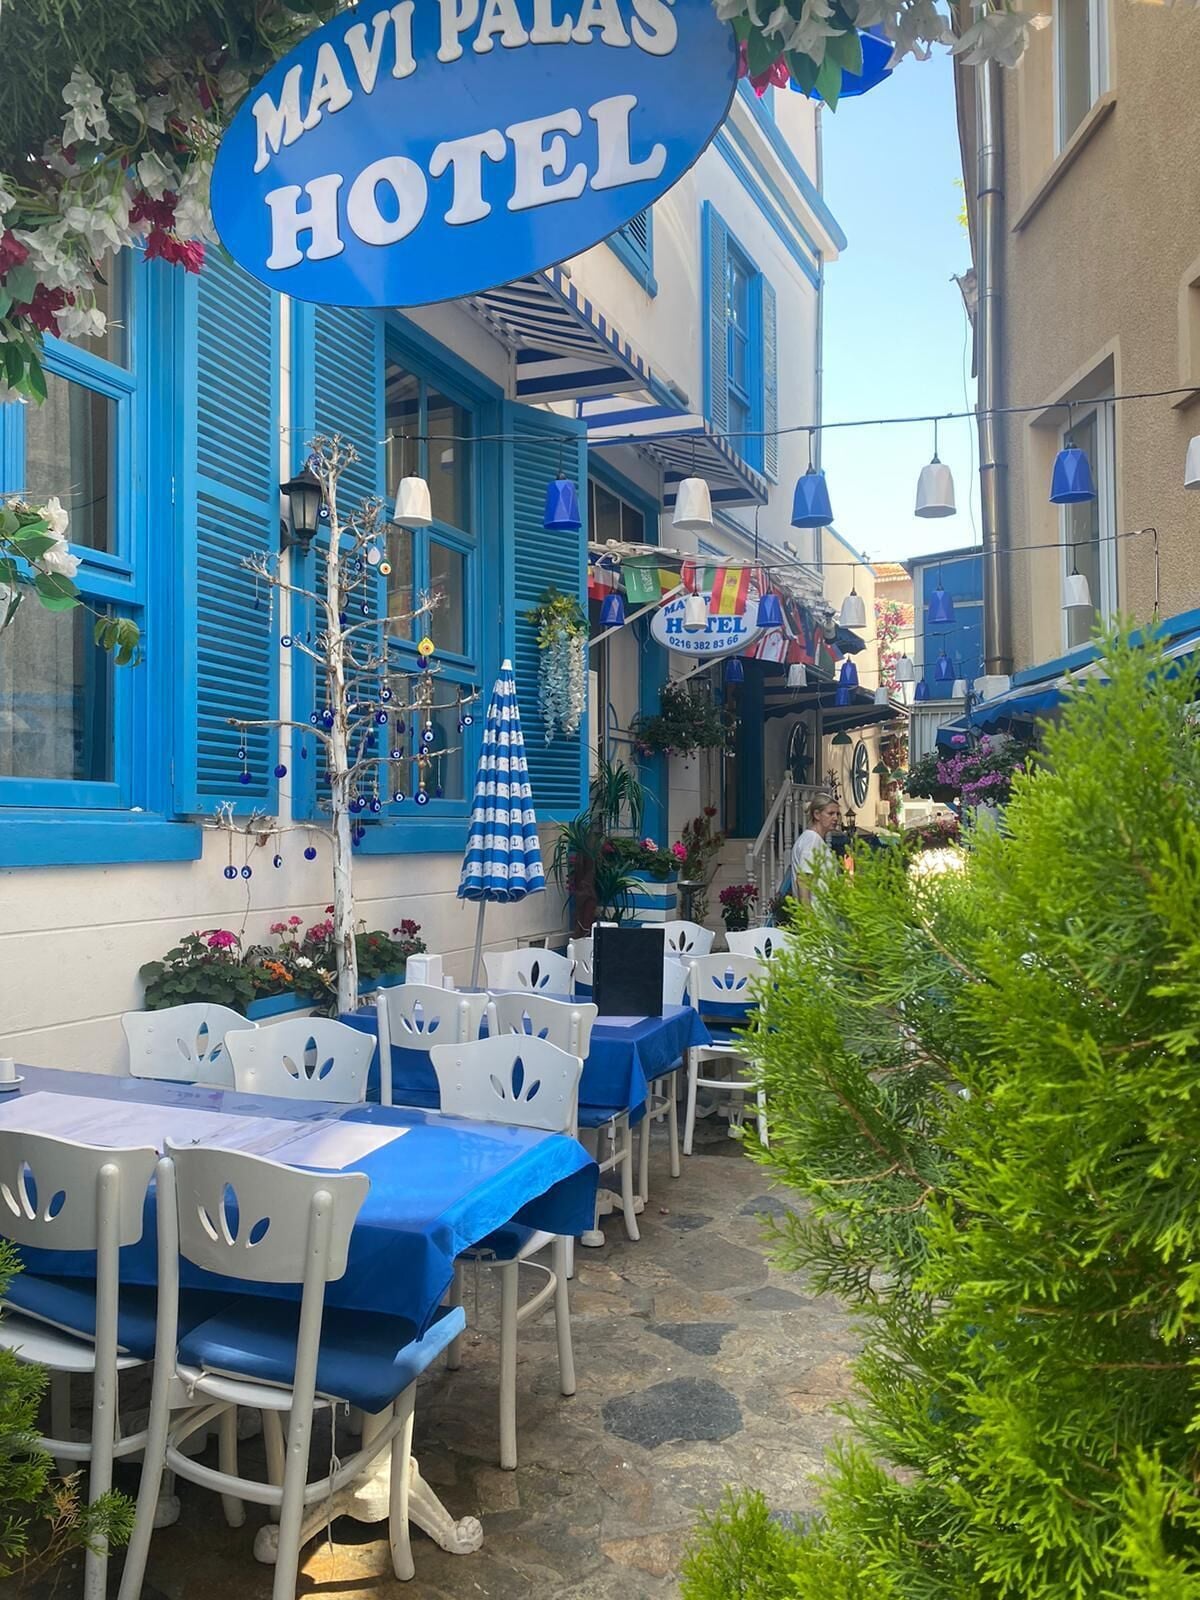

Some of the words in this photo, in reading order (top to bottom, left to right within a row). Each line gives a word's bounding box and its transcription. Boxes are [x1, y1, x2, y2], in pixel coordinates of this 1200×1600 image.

[252, 2, 416, 174] MAVI
[437, 0, 678, 62] PALAS
[265, 94, 667, 270] HOTEL
[666, 617, 747, 633] HTEL
[669, 636, 691, 649] 0216
[694, 642, 710, 650] 382
[713, 639, 724, 648] 83
[726, 634, 739, 646] 66
